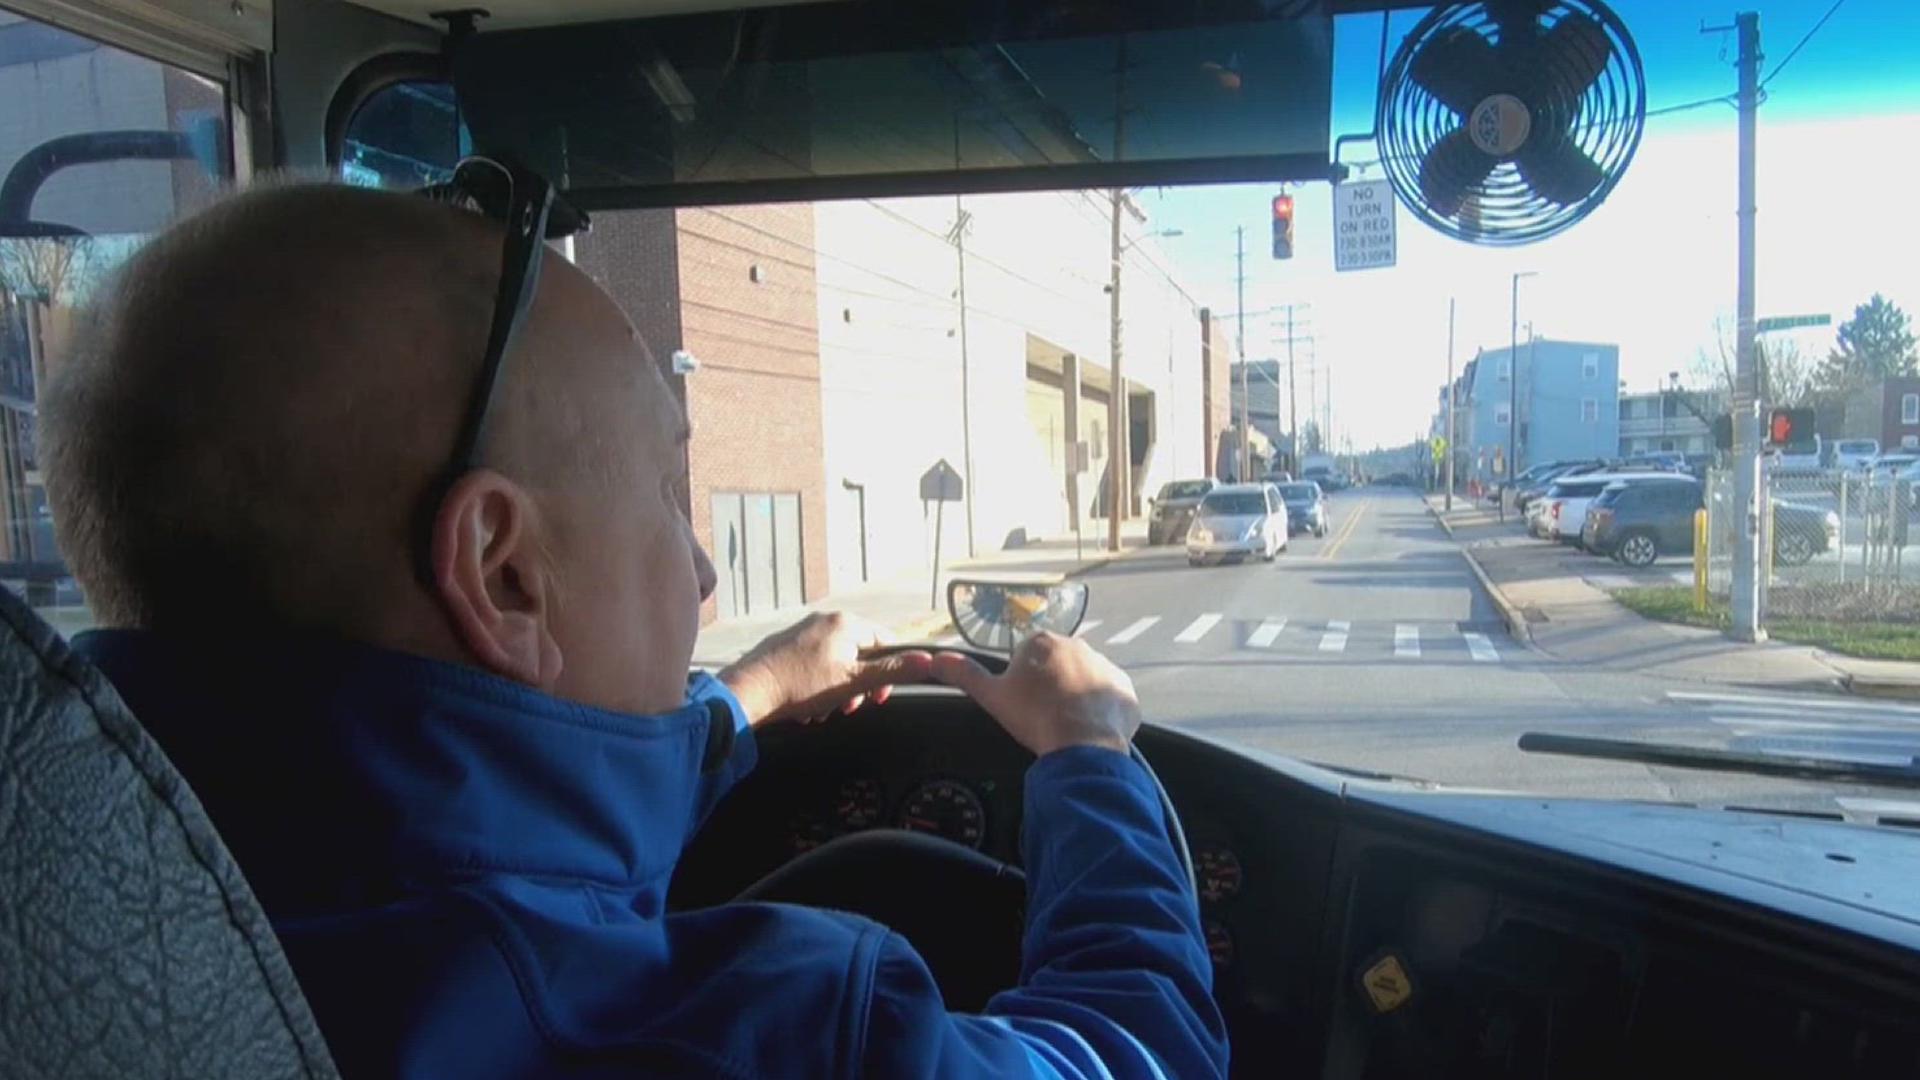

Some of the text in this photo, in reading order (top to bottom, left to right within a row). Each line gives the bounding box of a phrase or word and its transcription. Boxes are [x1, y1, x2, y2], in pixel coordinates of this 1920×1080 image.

[1353, 187, 1374, 200] NO
[1347, 203, 1382, 217] TURN
[1340, 217, 1389, 234] ON RED
